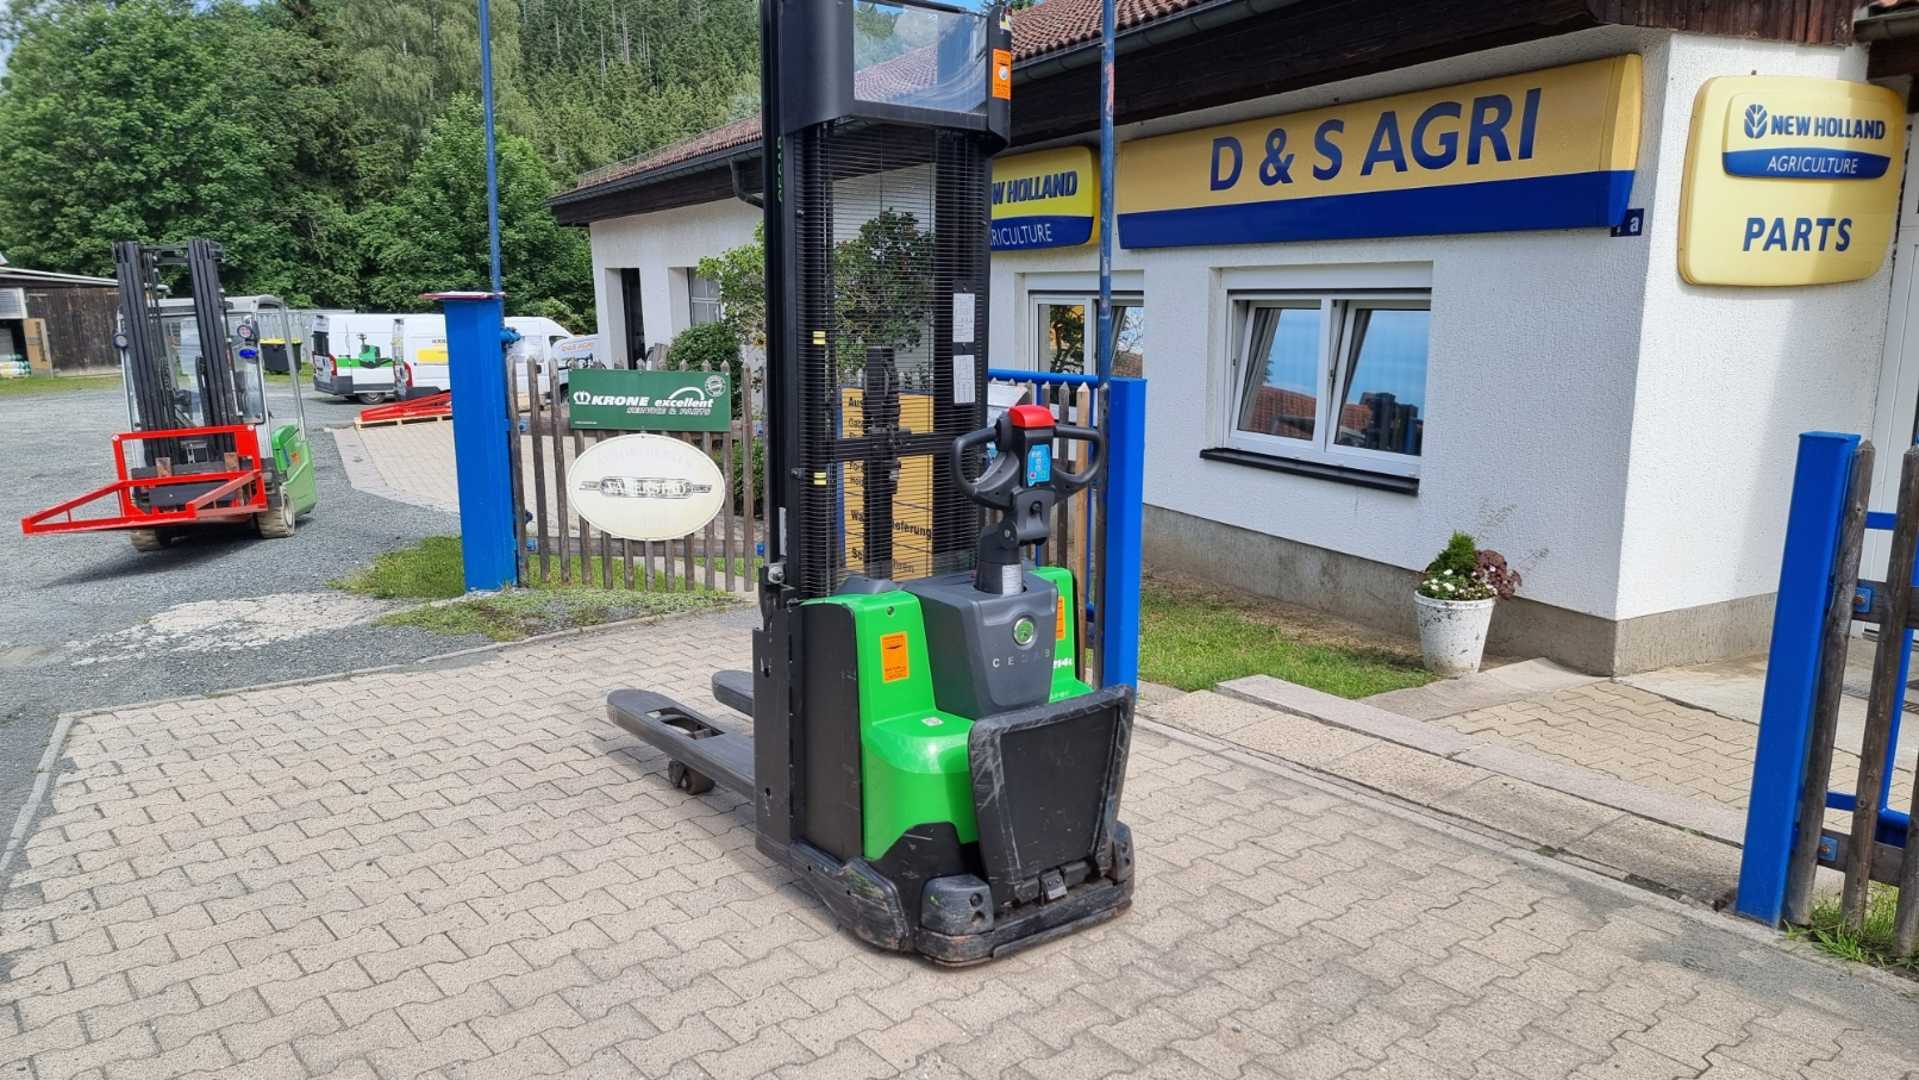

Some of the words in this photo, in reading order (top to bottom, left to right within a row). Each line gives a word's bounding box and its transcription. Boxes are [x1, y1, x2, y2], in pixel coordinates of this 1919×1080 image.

[1210, 136, 1243, 191] D
[1258, 128, 1295, 186] &
[1312, 119, 1344, 181] S
[1360, 87, 1542, 177] AGRI
[1770, 115, 1811, 136] NEW
[1814, 117, 1886, 140] HOLLAND
[1766, 155, 1858, 175] AGRICULTURE
[1006, 170, 1078, 204] HOLLAND
[990, 223, 1053, 247] RICULTURE
[1742, 217, 1852, 252] PARTS
[591, 395, 650, 407] KRONE
[654, 396, 714, 408] excellent
